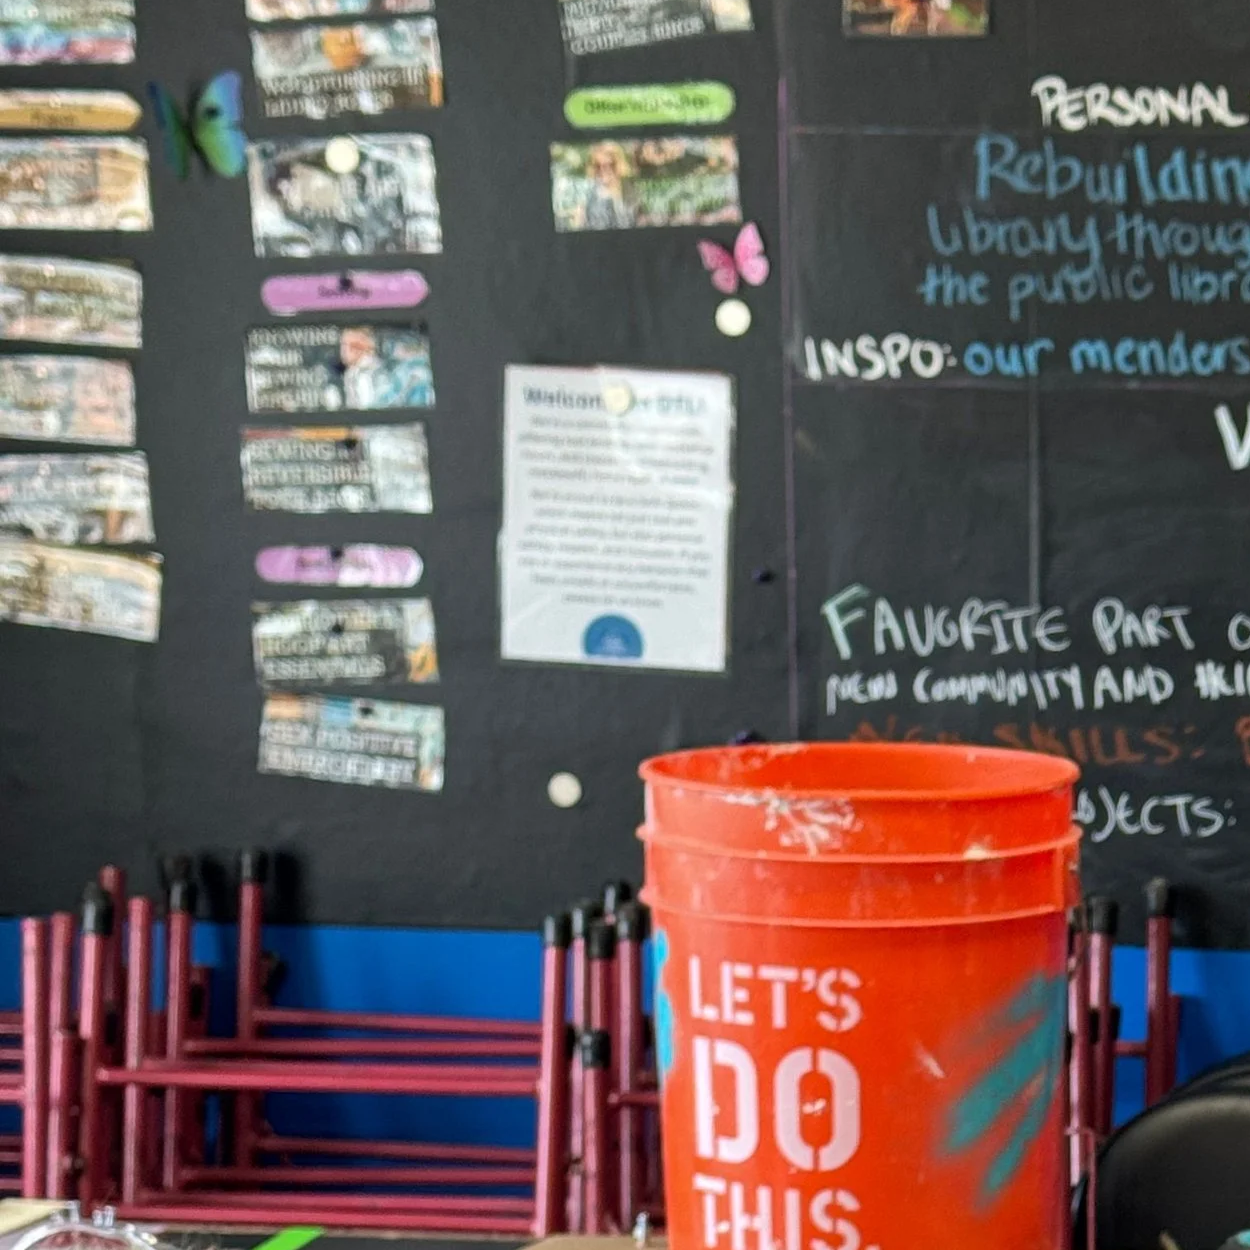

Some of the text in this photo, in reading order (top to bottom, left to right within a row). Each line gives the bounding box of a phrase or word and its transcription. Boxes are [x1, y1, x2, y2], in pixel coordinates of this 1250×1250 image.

[1030, 74, 1249, 131] PERSONAL
[916, 261, 991, 307] the
[1006, 264, 1154, 322] public
[963, 338, 1055, 378] our
[1091, 597, 1196, 655] PART
[1094, 664, 1175, 711] AND
[688, 955, 864, 1032] LET'S
[692, 1036, 861, 1172] DO
